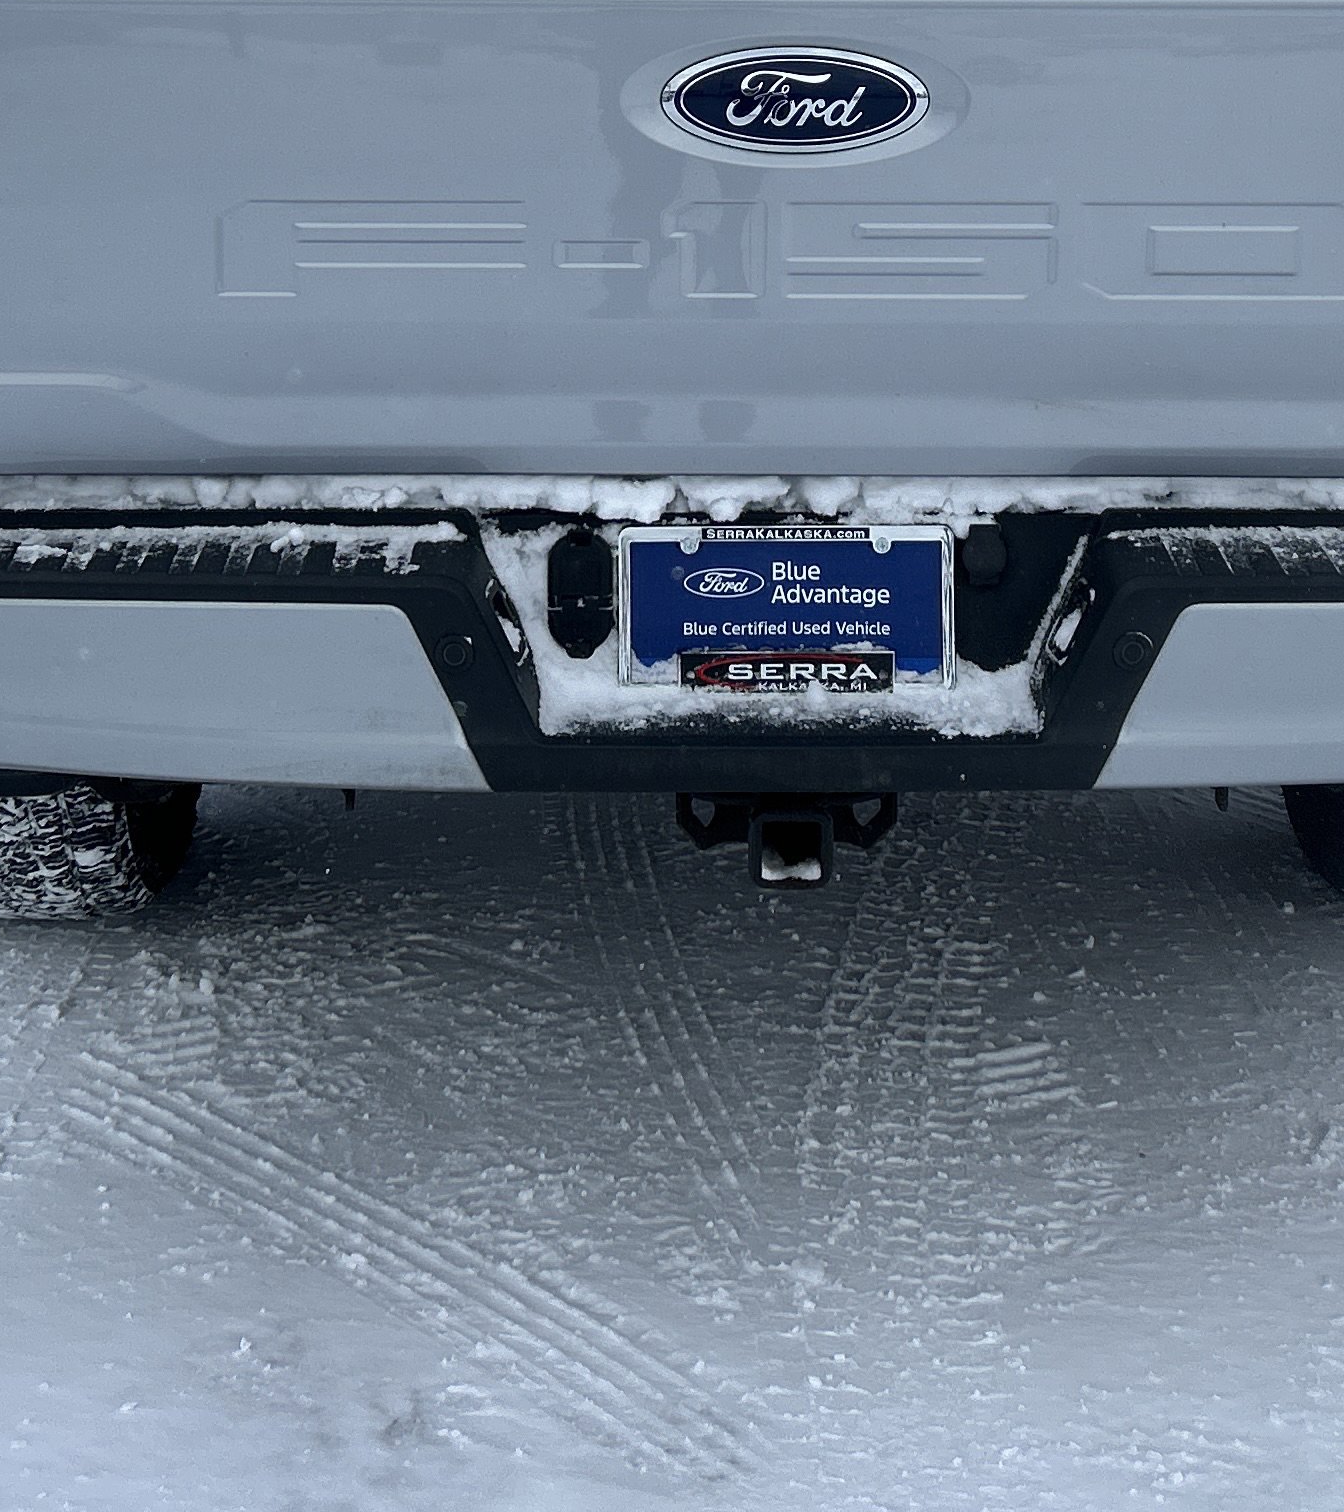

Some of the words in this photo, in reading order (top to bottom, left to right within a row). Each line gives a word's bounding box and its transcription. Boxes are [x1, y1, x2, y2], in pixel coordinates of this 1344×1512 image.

[725, 70, 866, 127] Ford
[772, 562, 821, 581] Blue
[699, 572, 749, 593] Ford
[771, 584, 891, 608] Advantage
[683, 622, 717, 636] Blue
[722, 621, 787, 636] Certified
[792, 621, 831, 636] Used
[836, 621, 891, 636] Vehicle
[728, 663, 878, 680] SERRA
[851, 682, 867, 691] MI
